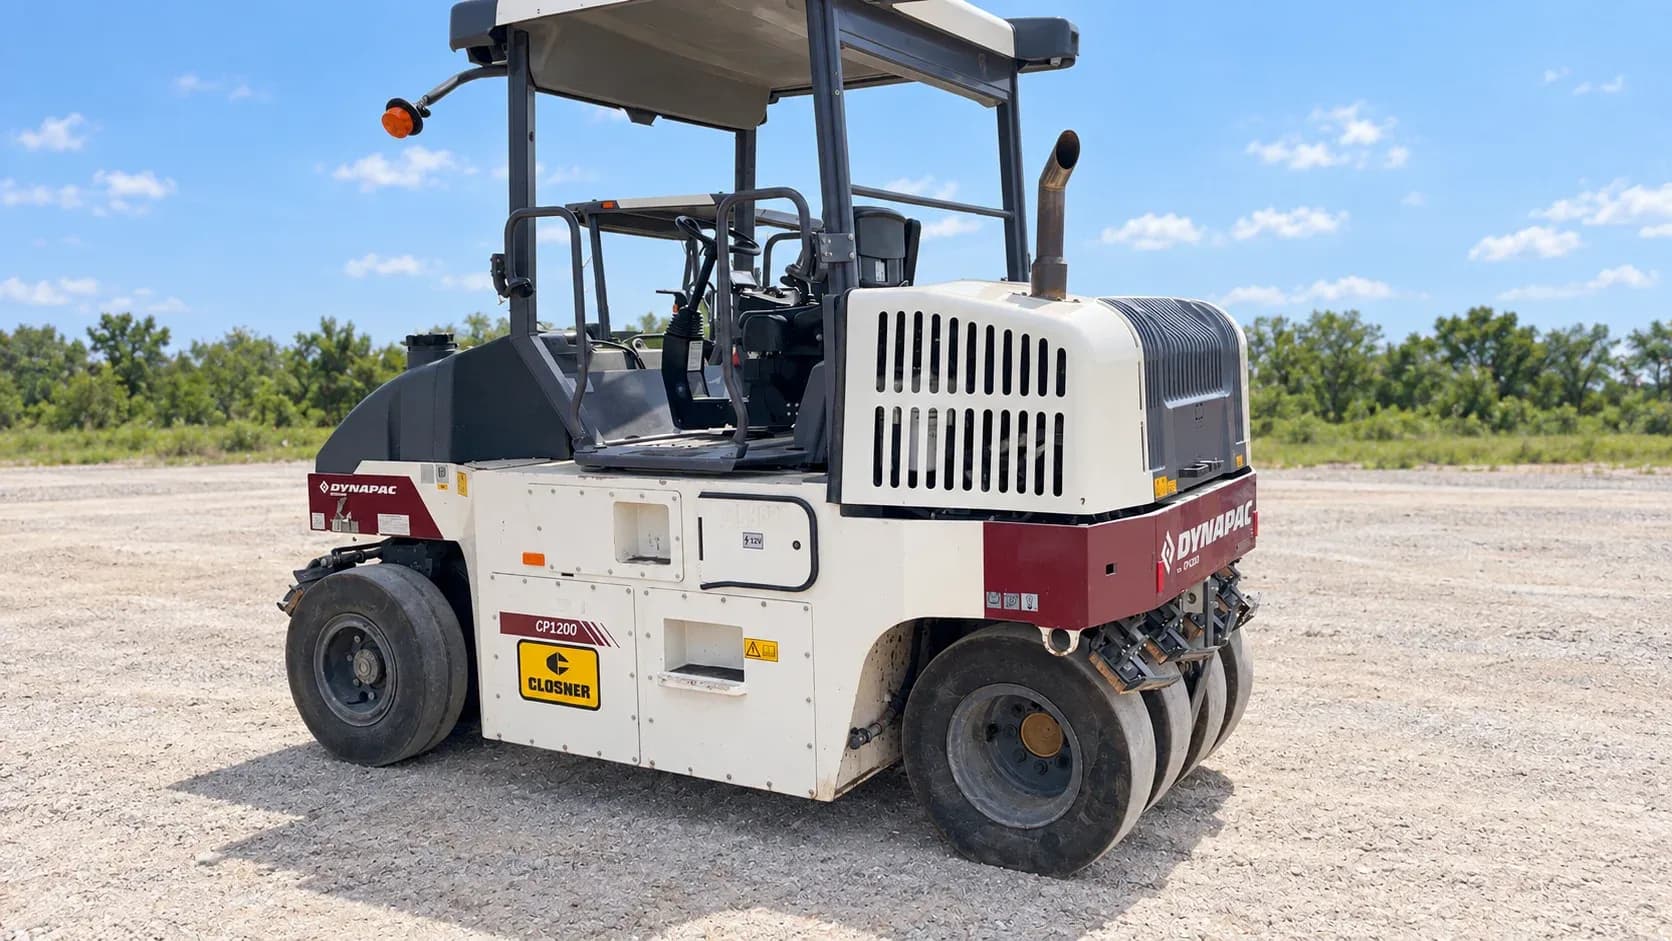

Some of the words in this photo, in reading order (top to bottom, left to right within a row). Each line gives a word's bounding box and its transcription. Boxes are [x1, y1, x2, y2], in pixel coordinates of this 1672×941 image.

[330, 483, 397, 495] DYNAPAC
[1177, 499, 1253, 561] DYNAPAC
[535, 620, 578, 636] CP1200
[528, 677, 591, 699] CLOSNER
